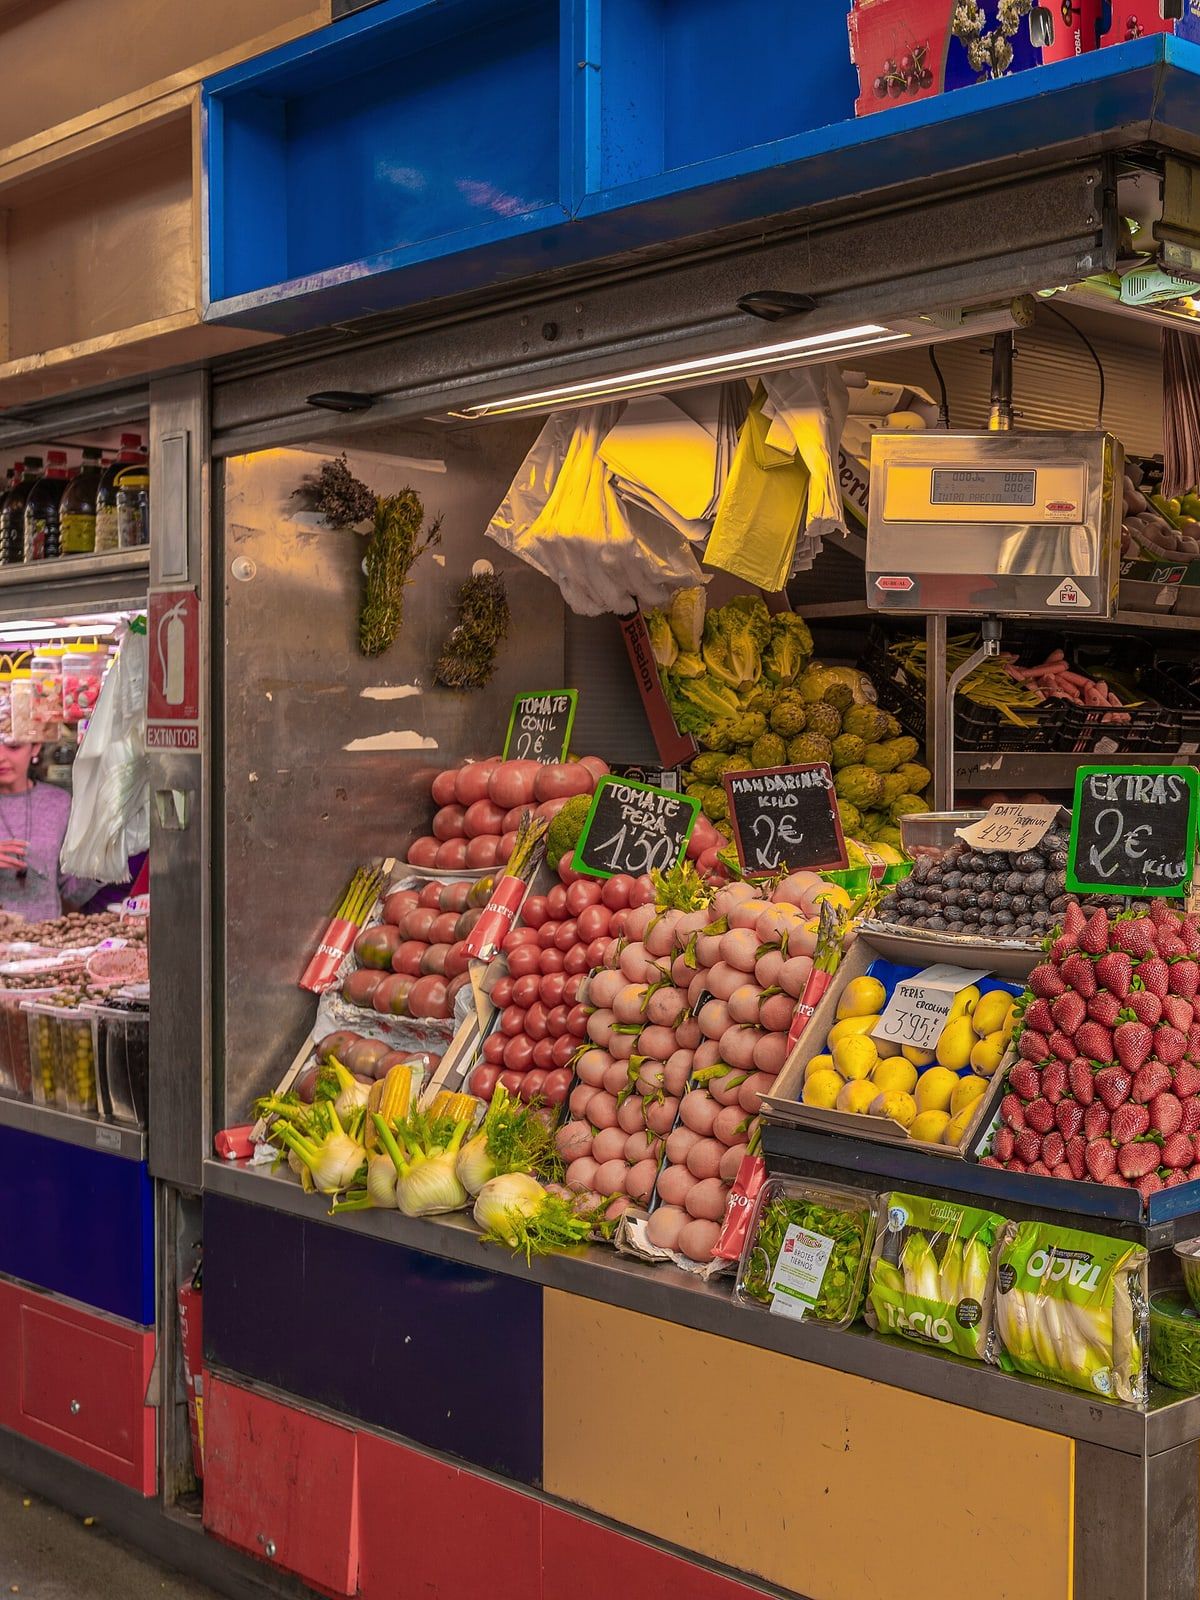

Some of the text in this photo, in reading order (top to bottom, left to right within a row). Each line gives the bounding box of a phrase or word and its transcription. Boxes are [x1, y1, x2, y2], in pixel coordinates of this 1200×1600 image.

[519, 695, 567, 714] TOMATE
[521, 715, 556, 732] CONIL
[148, 728, 197, 746] EXTINTOR
[732, 768, 833, 794] MANDARINAS
[1090, 774, 1186, 804] EXTRAS
[606, 783, 680, 817] TOMATE
[620, 804, 667, 834] PERA
[900, 987, 925, 998] PERAS
[791, 1256, 813, 1271] TIERNOS
[794, 1249, 814, 1262] BROTES
[1027, 1250, 1101, 1292] TACIO
[884, 1302, 953, 1344] TACIO
